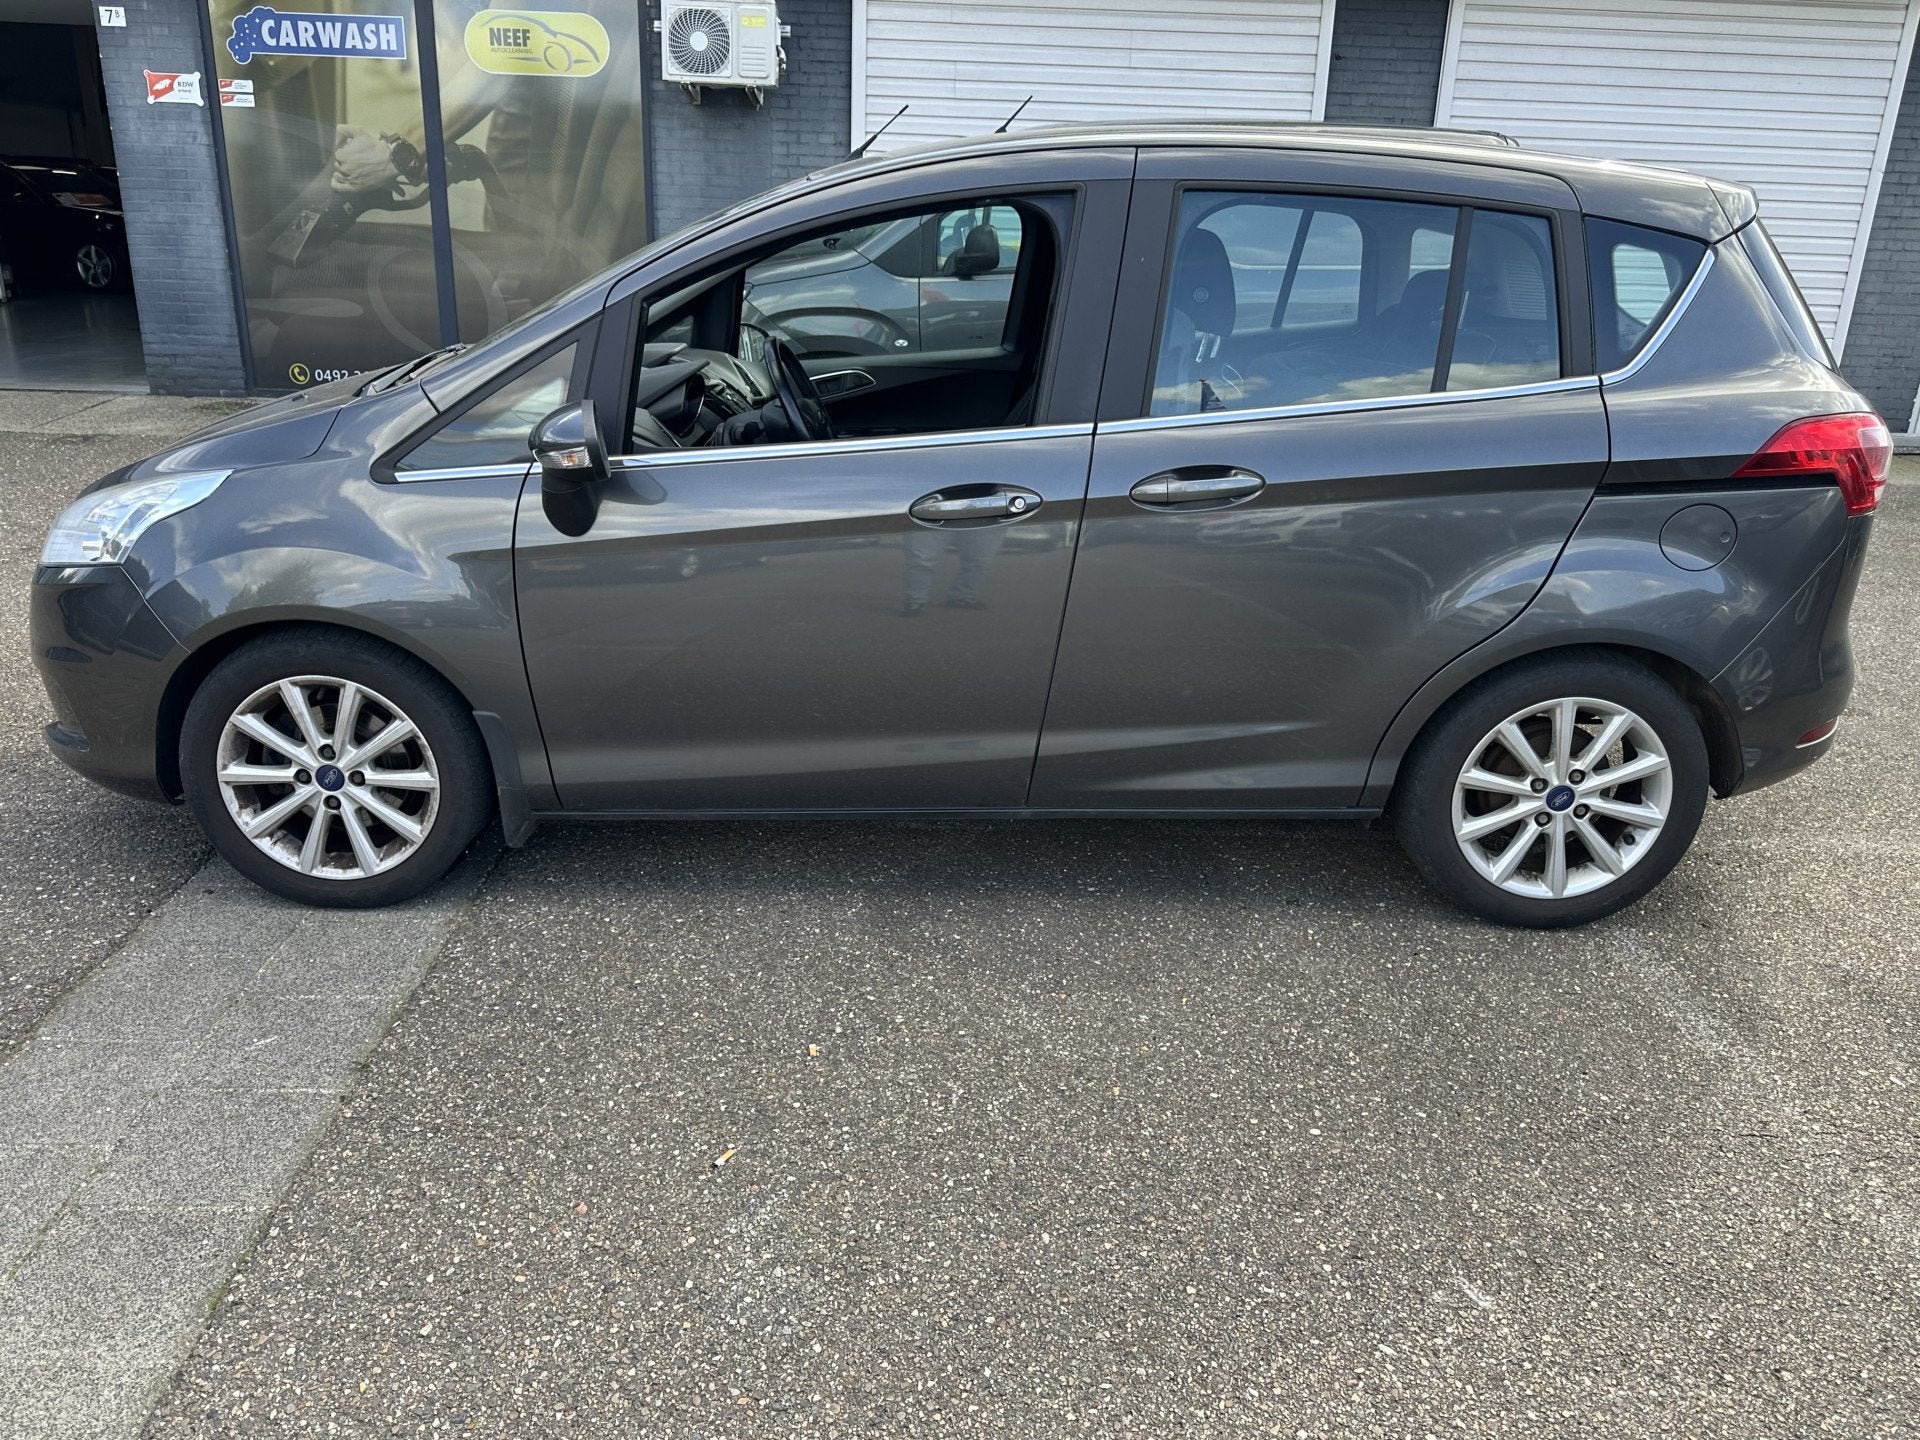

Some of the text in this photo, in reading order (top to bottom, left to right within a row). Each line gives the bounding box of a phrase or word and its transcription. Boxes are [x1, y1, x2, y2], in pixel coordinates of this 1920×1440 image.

[261, 19, 398, 51] CARWASH
[489, 27, 531, 47] NEEF
[315, 369, 349, 381] 0492
